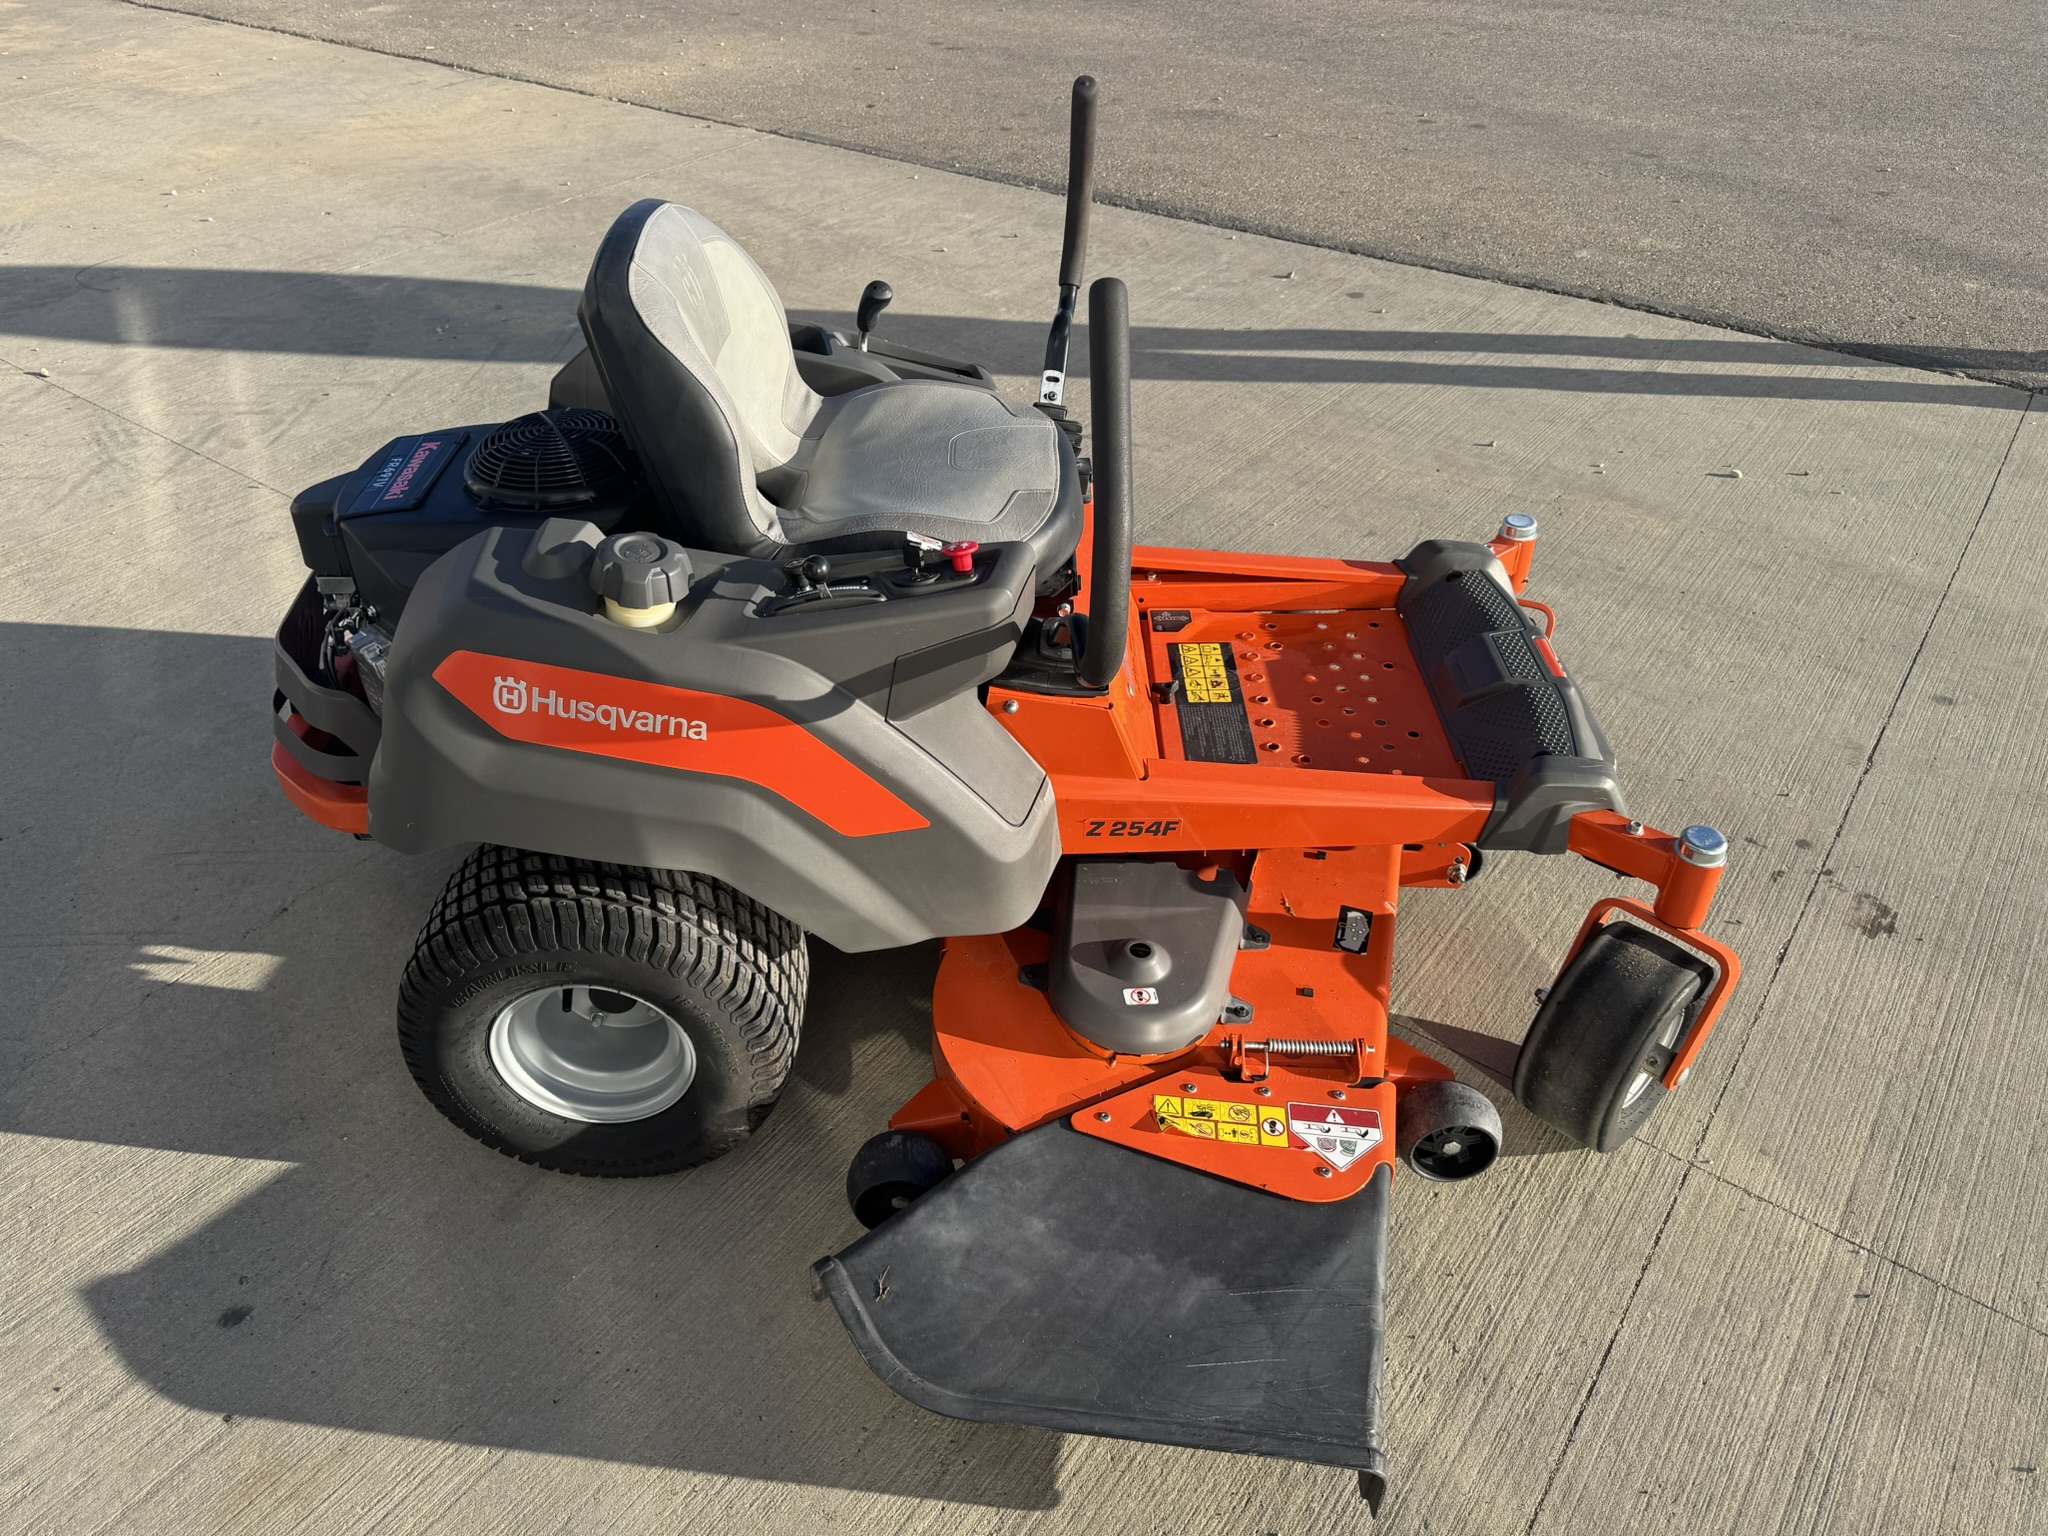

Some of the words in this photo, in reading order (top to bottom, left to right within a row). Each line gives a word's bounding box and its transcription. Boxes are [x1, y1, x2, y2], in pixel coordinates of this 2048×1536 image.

[372, 457, 403, 488] FR691V
[383, 441, 441, 500] Kawasaki
[531, 686, 708, 741] Husqvarna
[1085, 821, 1106, 837] Z
[1109, 821, 1180, 837] 254F
[452, 961, 578, 1008] CARLISLE
